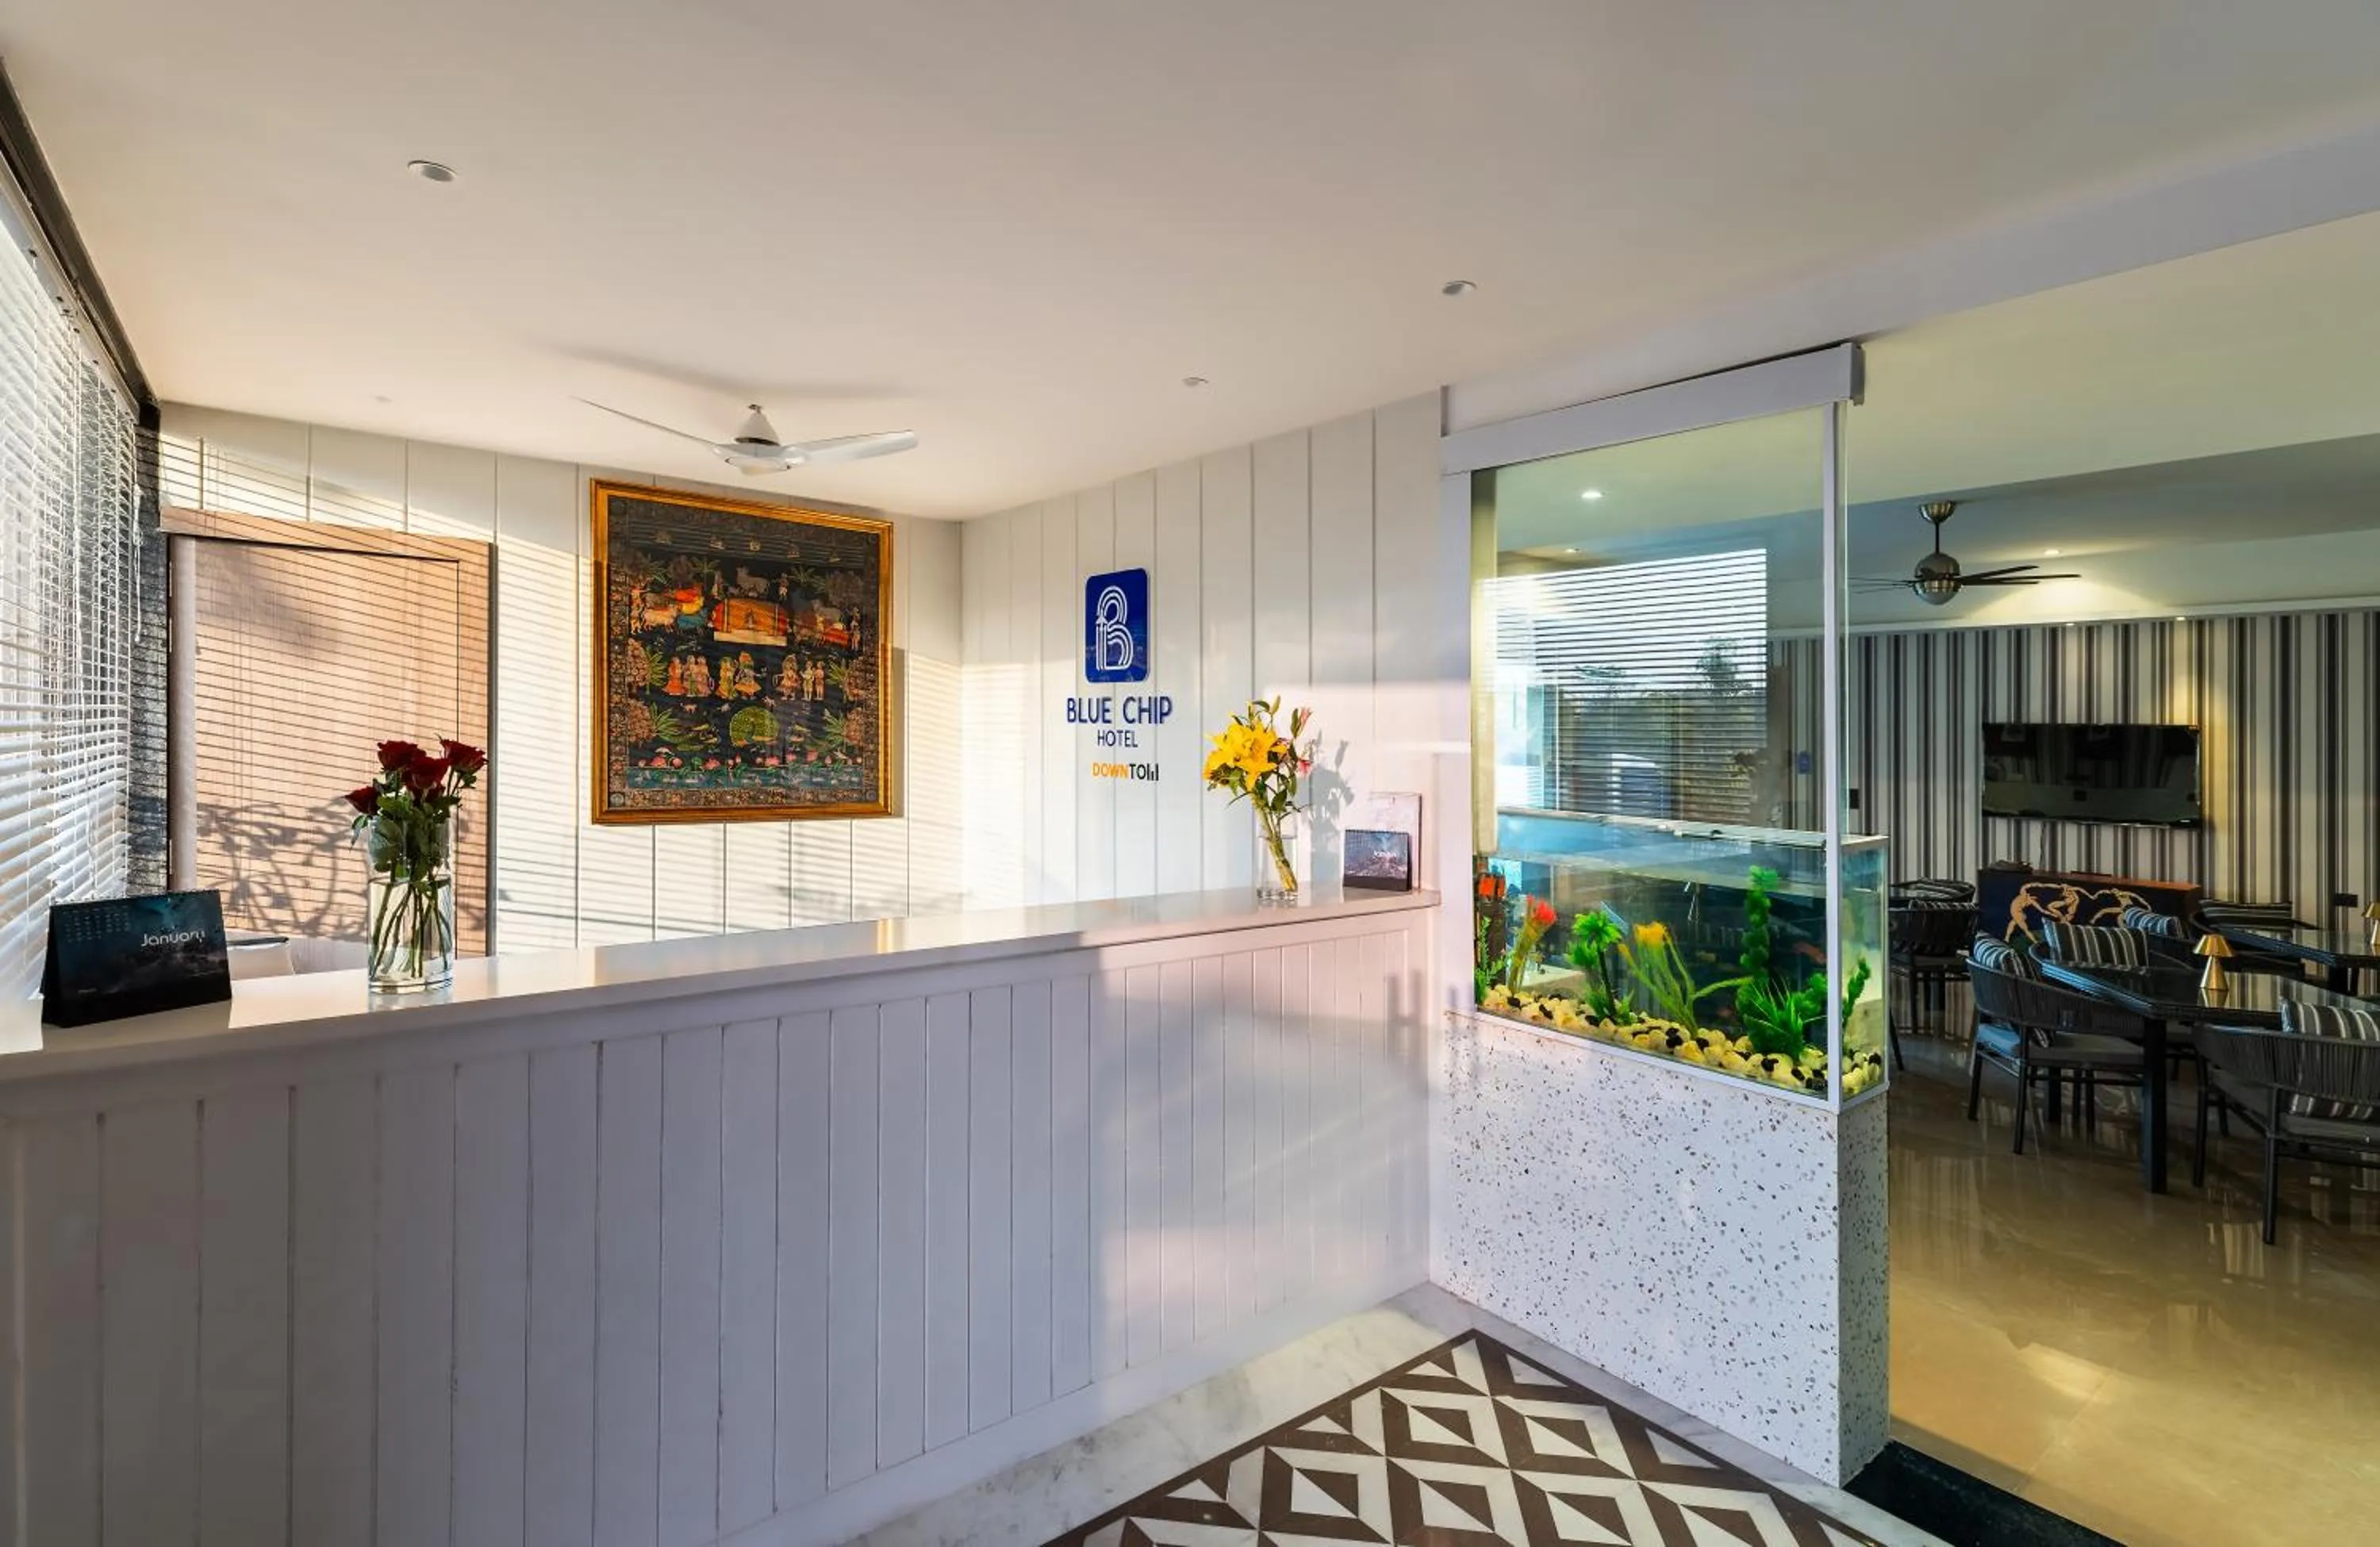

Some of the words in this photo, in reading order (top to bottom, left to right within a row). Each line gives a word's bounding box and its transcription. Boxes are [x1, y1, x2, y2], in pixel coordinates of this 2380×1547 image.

[1066, 697, 1112, 724] BLUE
[1123, 696, 1173, 724] CHIP
[1097, 729, 1138, 747] HOTEL
[140, 931, 205, 946] January
